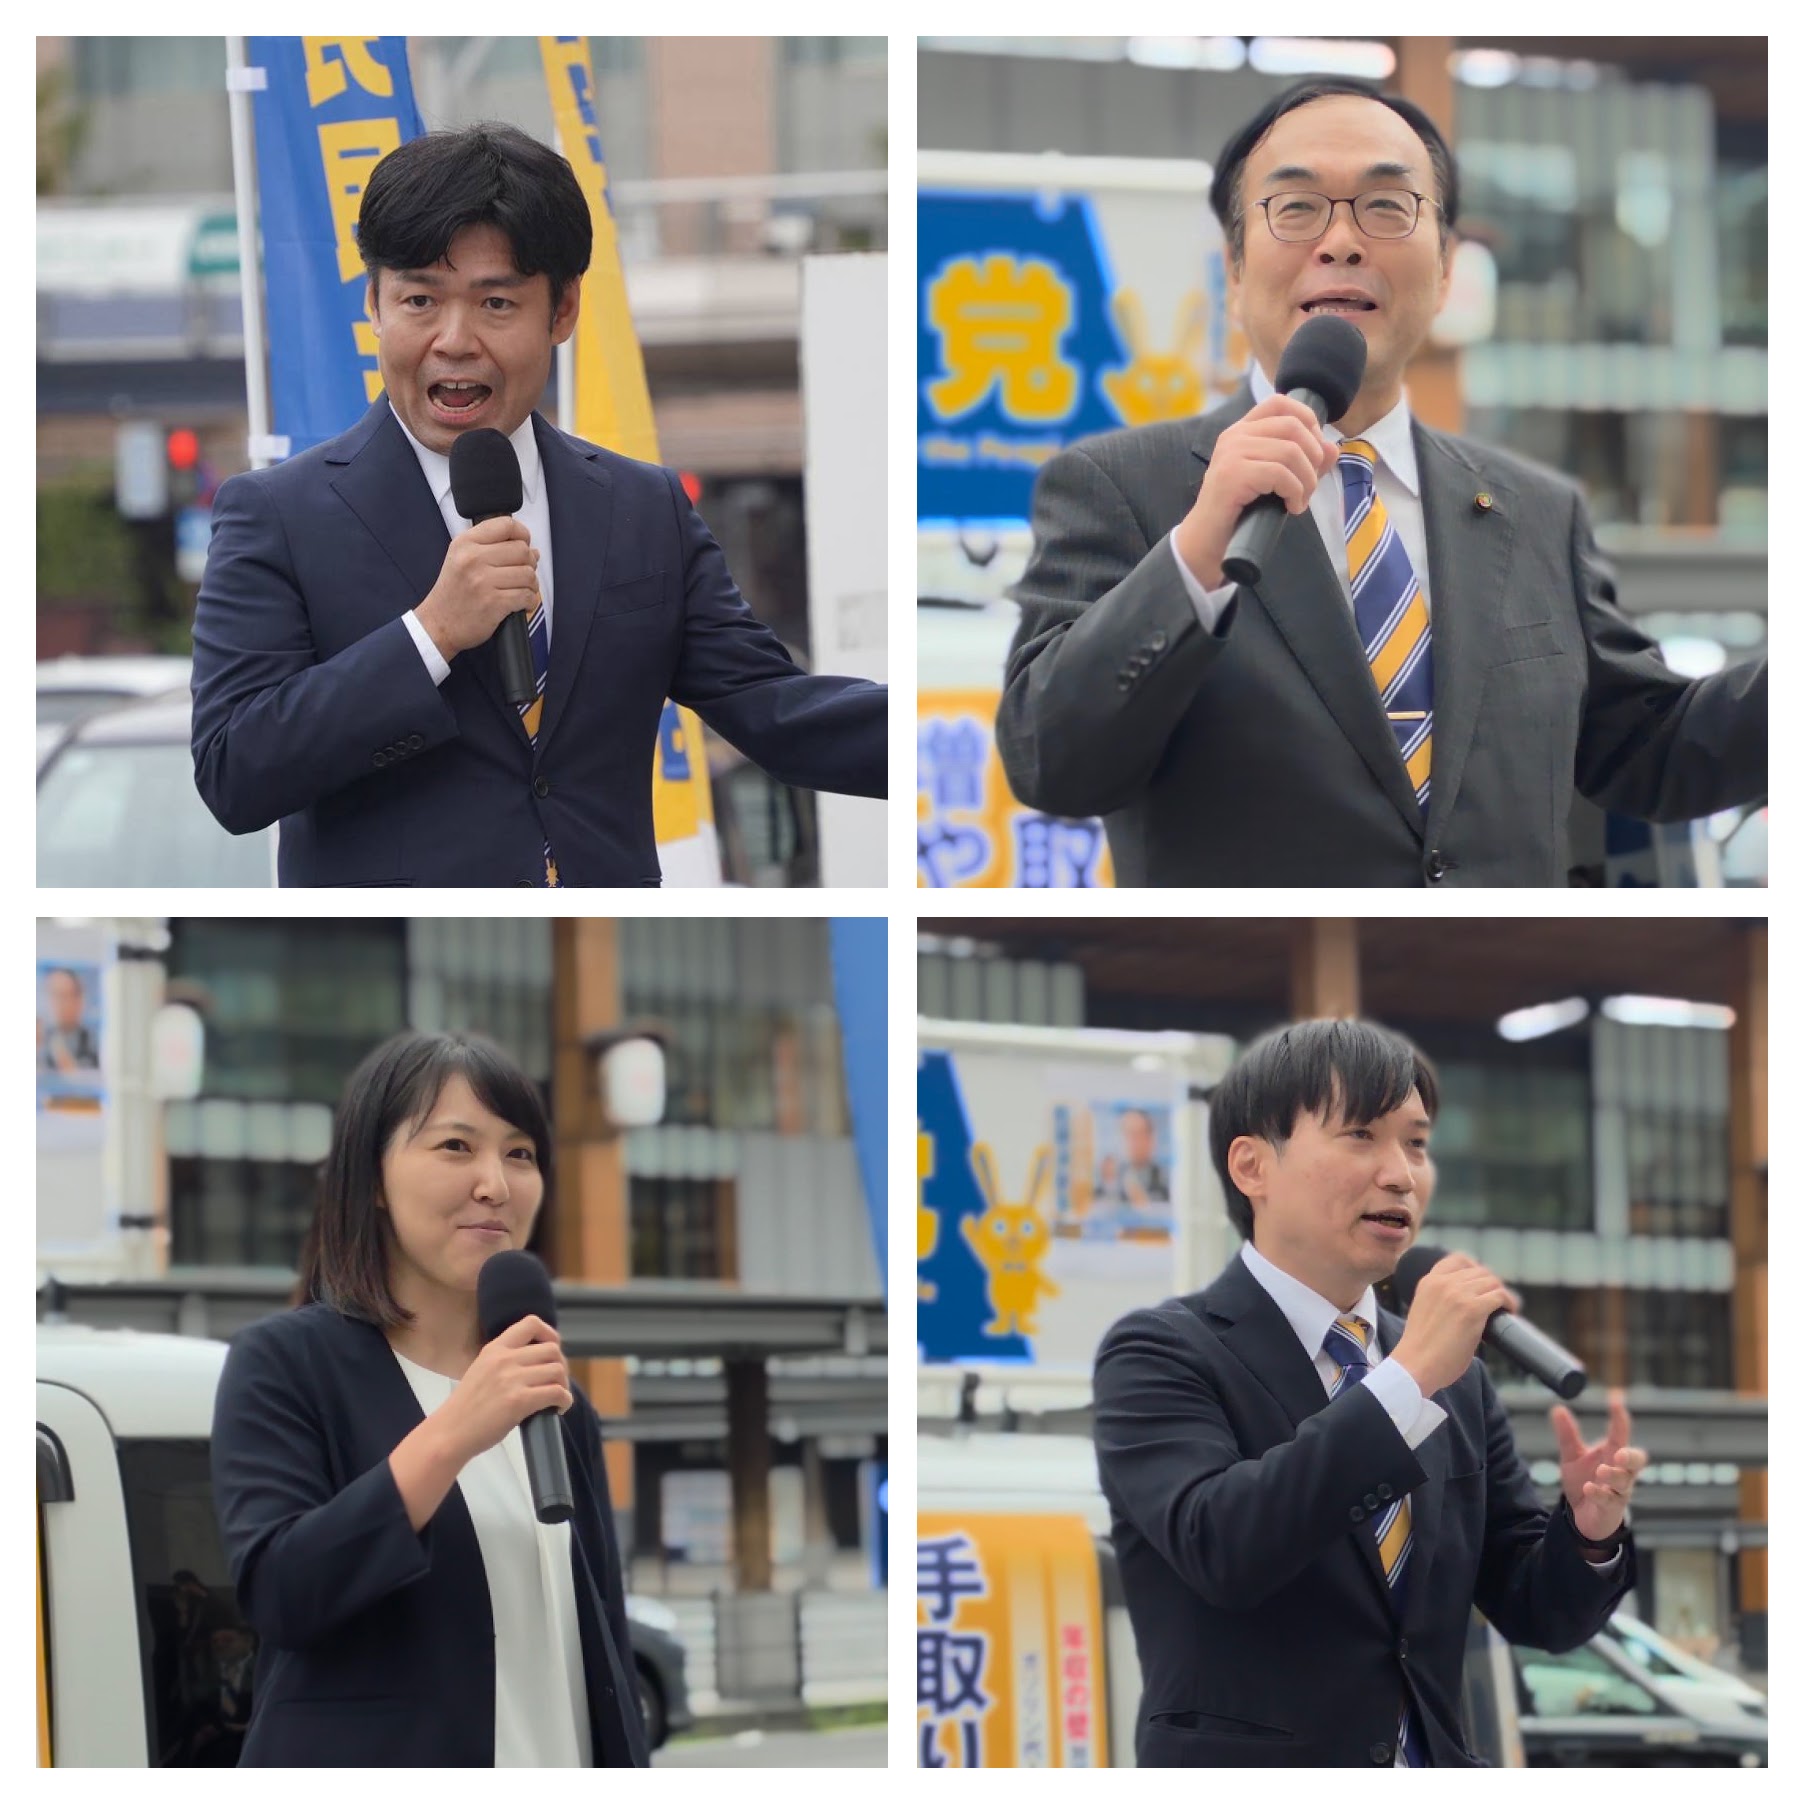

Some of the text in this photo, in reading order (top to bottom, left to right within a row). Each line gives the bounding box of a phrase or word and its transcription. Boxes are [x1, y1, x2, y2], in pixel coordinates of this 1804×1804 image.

[930, 254, 1074, 418] 党
[917, 1537, 986, 1768] 手取り
